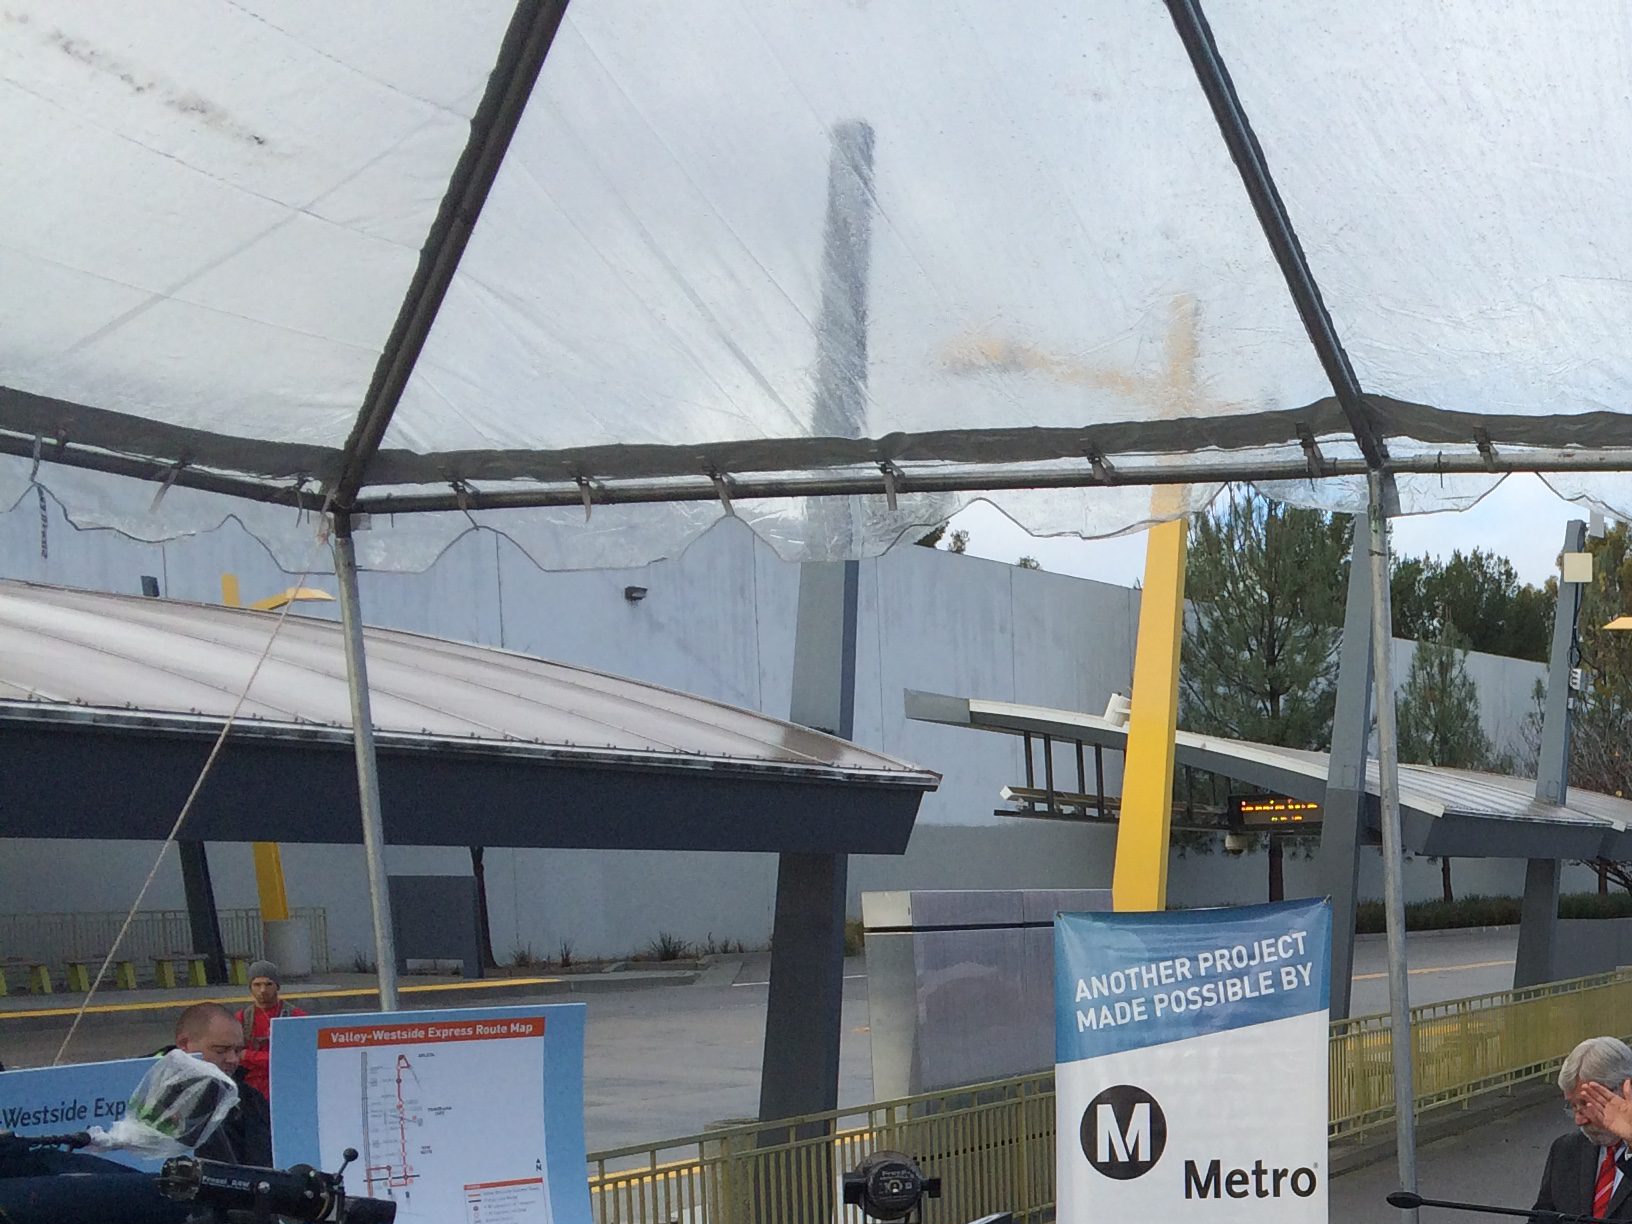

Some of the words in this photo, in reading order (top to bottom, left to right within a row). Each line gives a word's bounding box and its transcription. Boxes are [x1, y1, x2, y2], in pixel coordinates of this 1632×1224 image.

[1075, 957, 1192, 1002] ANOTHER
[1199, 931, 1307, 975] PROJECT
[1076, 997, 1148, 1032] MADE
[1156, 971, 1274, 1017] POSSIBLE
[1281, 962, 1313, 989] BY
[331, 1028, 424, 1044] Valley-Westside
[428, 1026, 473, 1039] Express
[476, 1024, 508, 1035] Route
[510, 1022, 533, 1035] Map
[1184, 1159, 1317, 1199] Metro
